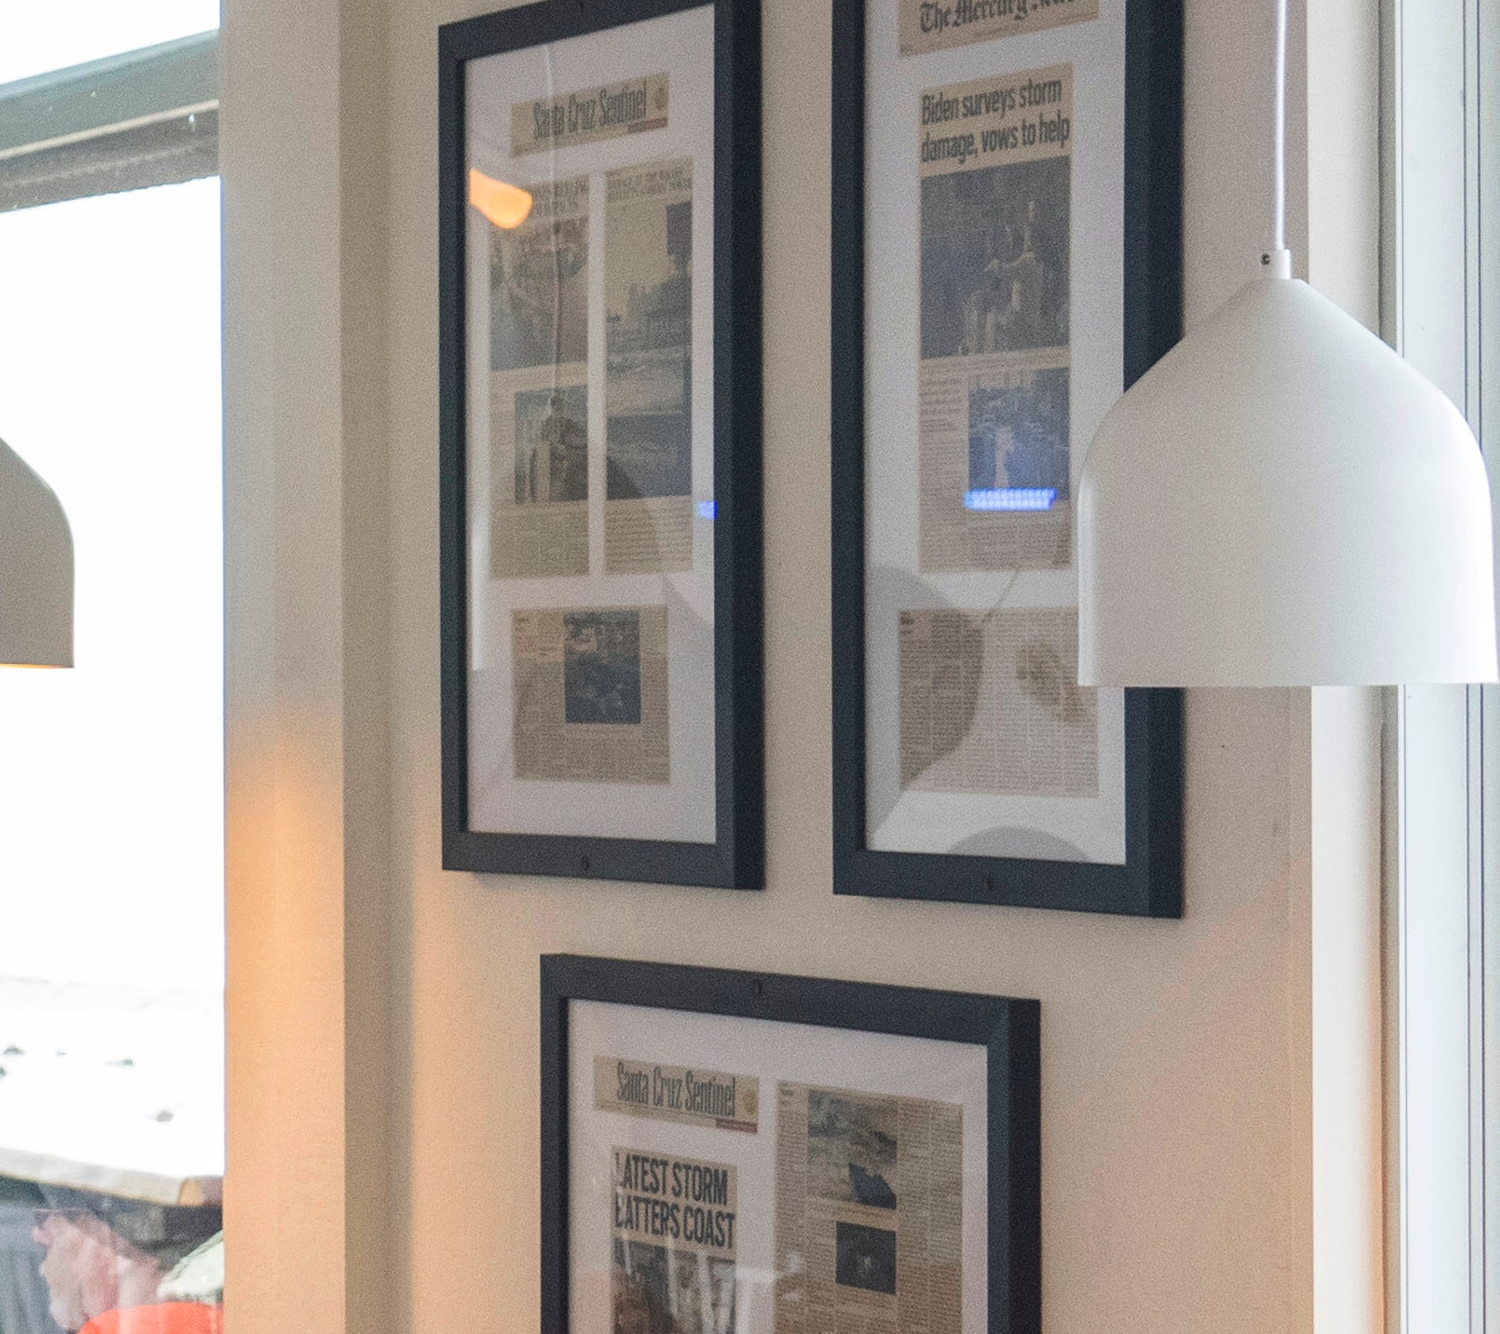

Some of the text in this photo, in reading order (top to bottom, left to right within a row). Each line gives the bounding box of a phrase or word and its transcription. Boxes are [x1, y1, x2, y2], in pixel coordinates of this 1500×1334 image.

[919, 0, 949, 33] The
[533, 78, 647, 141] Santa Cruz Sentinel
[921, 79, 1062, 126] Biden surveys storm
[921, 109, 1071, 164] damage, vows to help
[617, 1061, 737, 1118] Santa Cruz Sentinel
[671, 1161, 728, 1206] STORM
[683, 1206, 736, 1249] COAST
